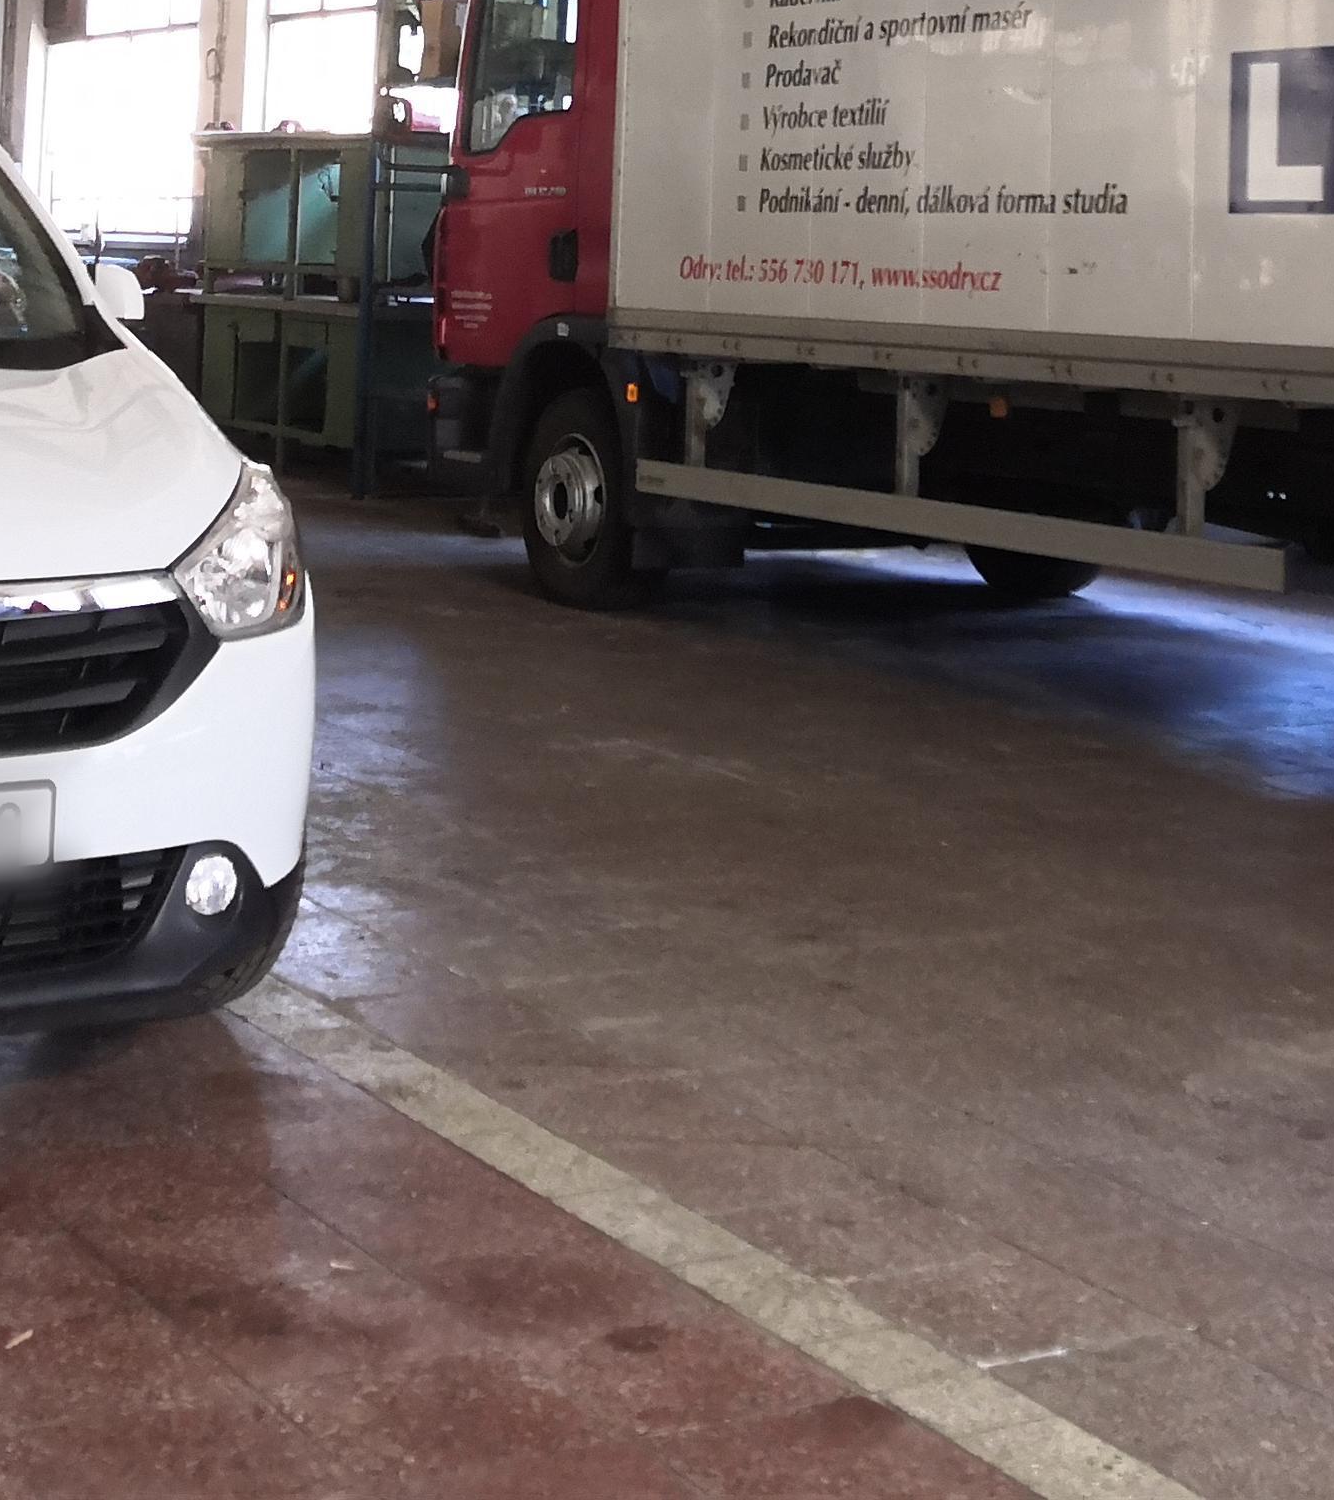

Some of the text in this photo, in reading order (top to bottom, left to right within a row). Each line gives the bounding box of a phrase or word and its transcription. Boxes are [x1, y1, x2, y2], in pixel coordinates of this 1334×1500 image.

[768, 1, 1033, 49] Rekondiční a sportovní masér
[765, 58, 842, 89] Prodavač
[762, 97, 890, 137] Výrobce textilií
[1246, 61, 1324, 202] L
[759, 141, 917, 177] Kosmetické služby
[758, 186, 843, 215] Podnikání
[855, 186, 912, 220] denní,
[917, 184, 991, 215] dálková
[995, 184, 1056, 215] forma
[1062, 182, 1129, 215] studia
[679, 255, 723, 288] Odry:
[758, 258, 788, 284] 556
[793, 259, 825, 285] 730
[831, 259, 865, 290] 171,
